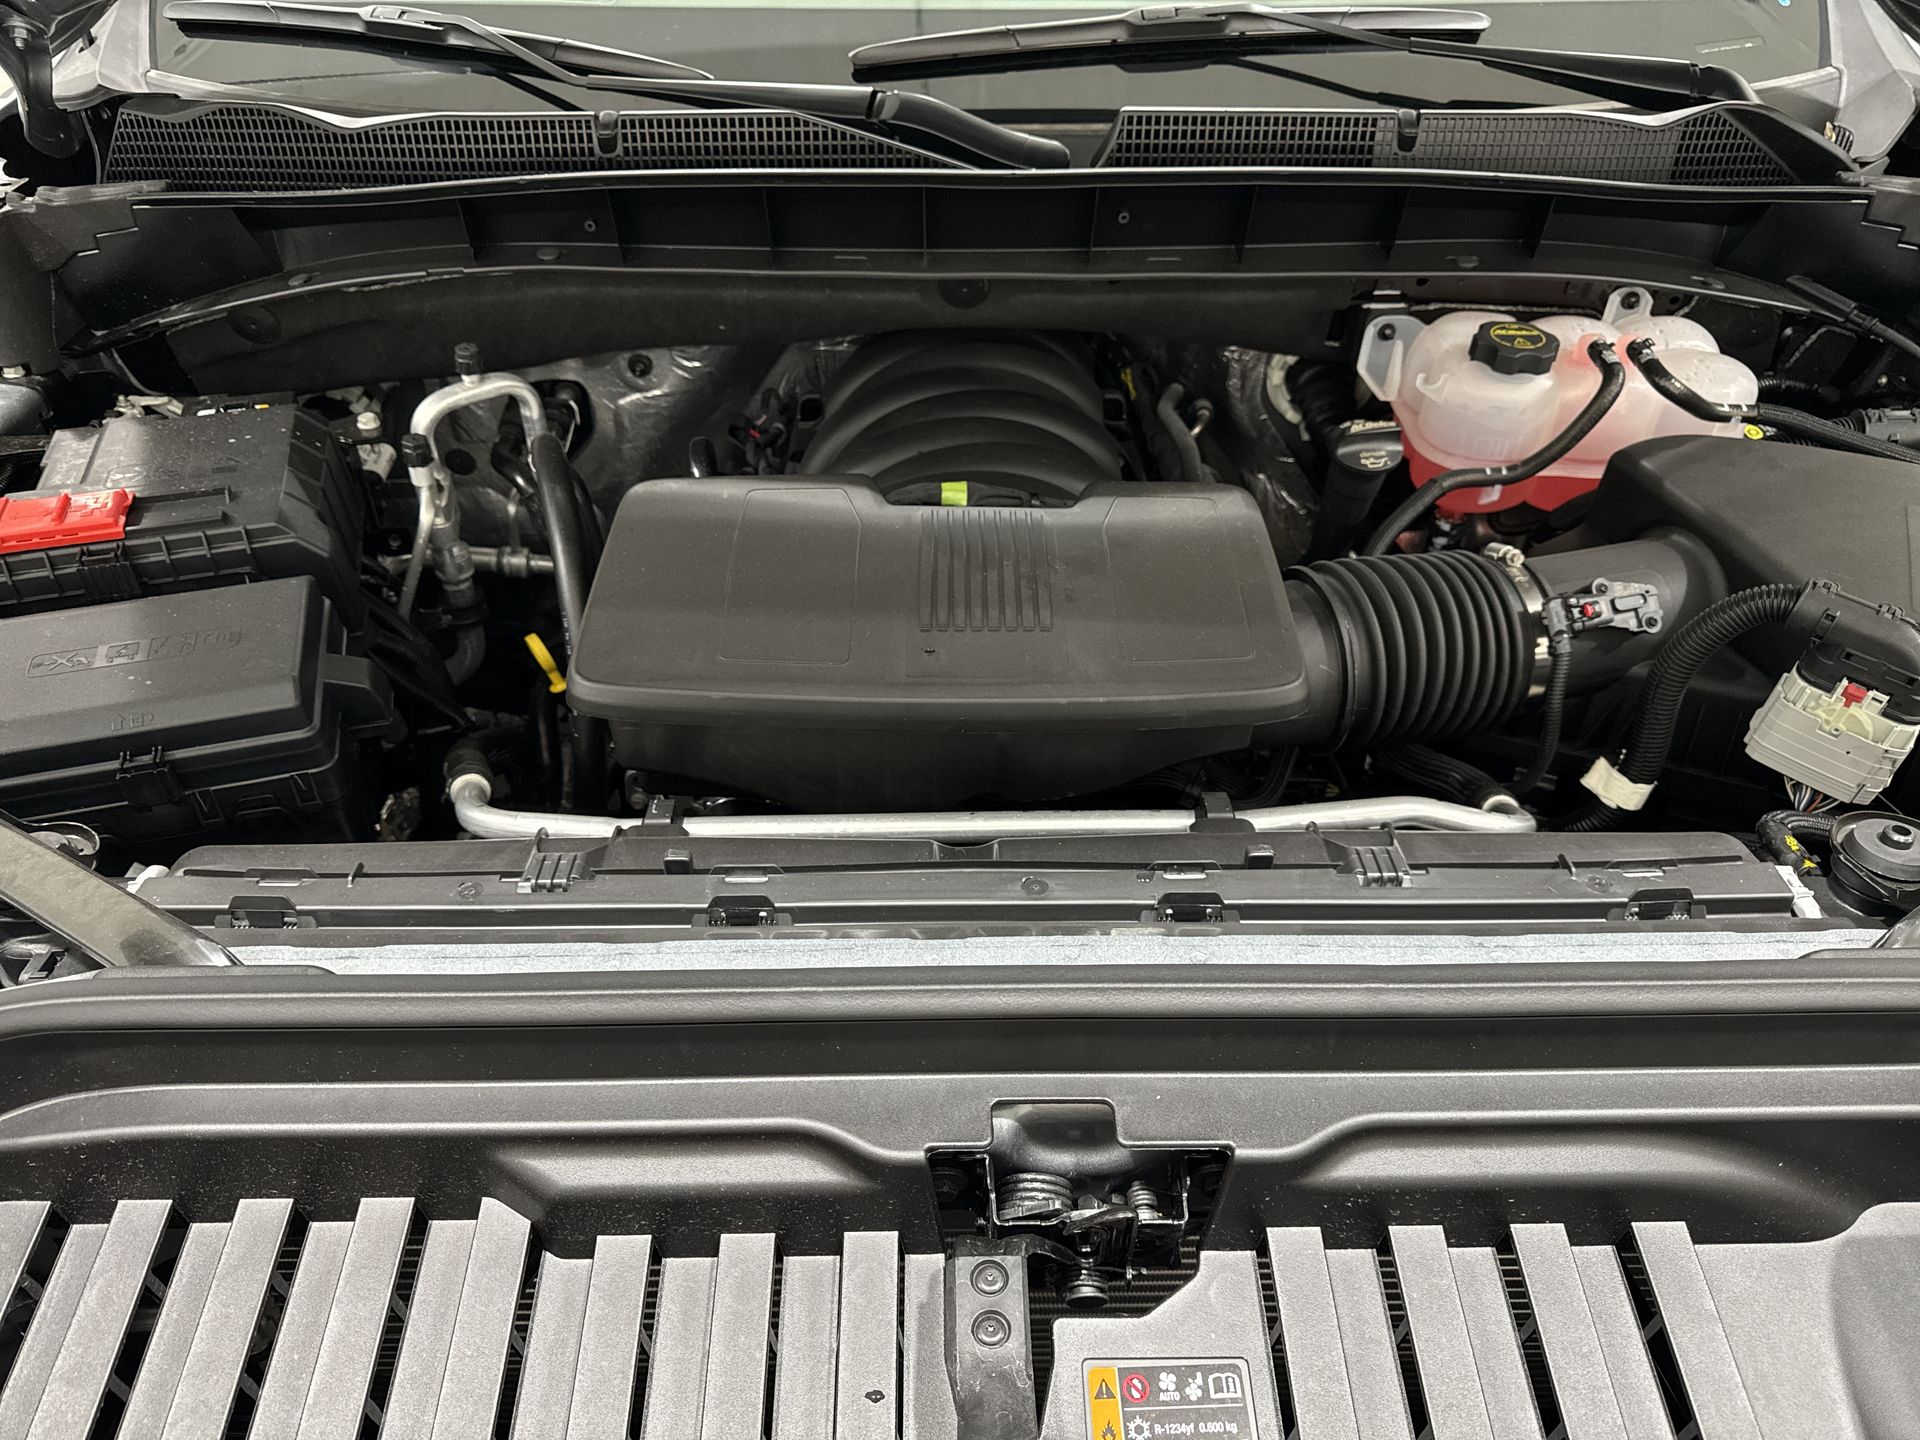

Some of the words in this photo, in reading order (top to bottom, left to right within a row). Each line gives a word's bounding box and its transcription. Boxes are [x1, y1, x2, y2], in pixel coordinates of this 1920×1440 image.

[1159, 1391, 1180, 1402] AUTO
[1154, 1423, 1195, 1436] R-1234yf
[1198, 1422, 1225, 1434] 0.600
[1225, 1421, 1238, 1434] kg
